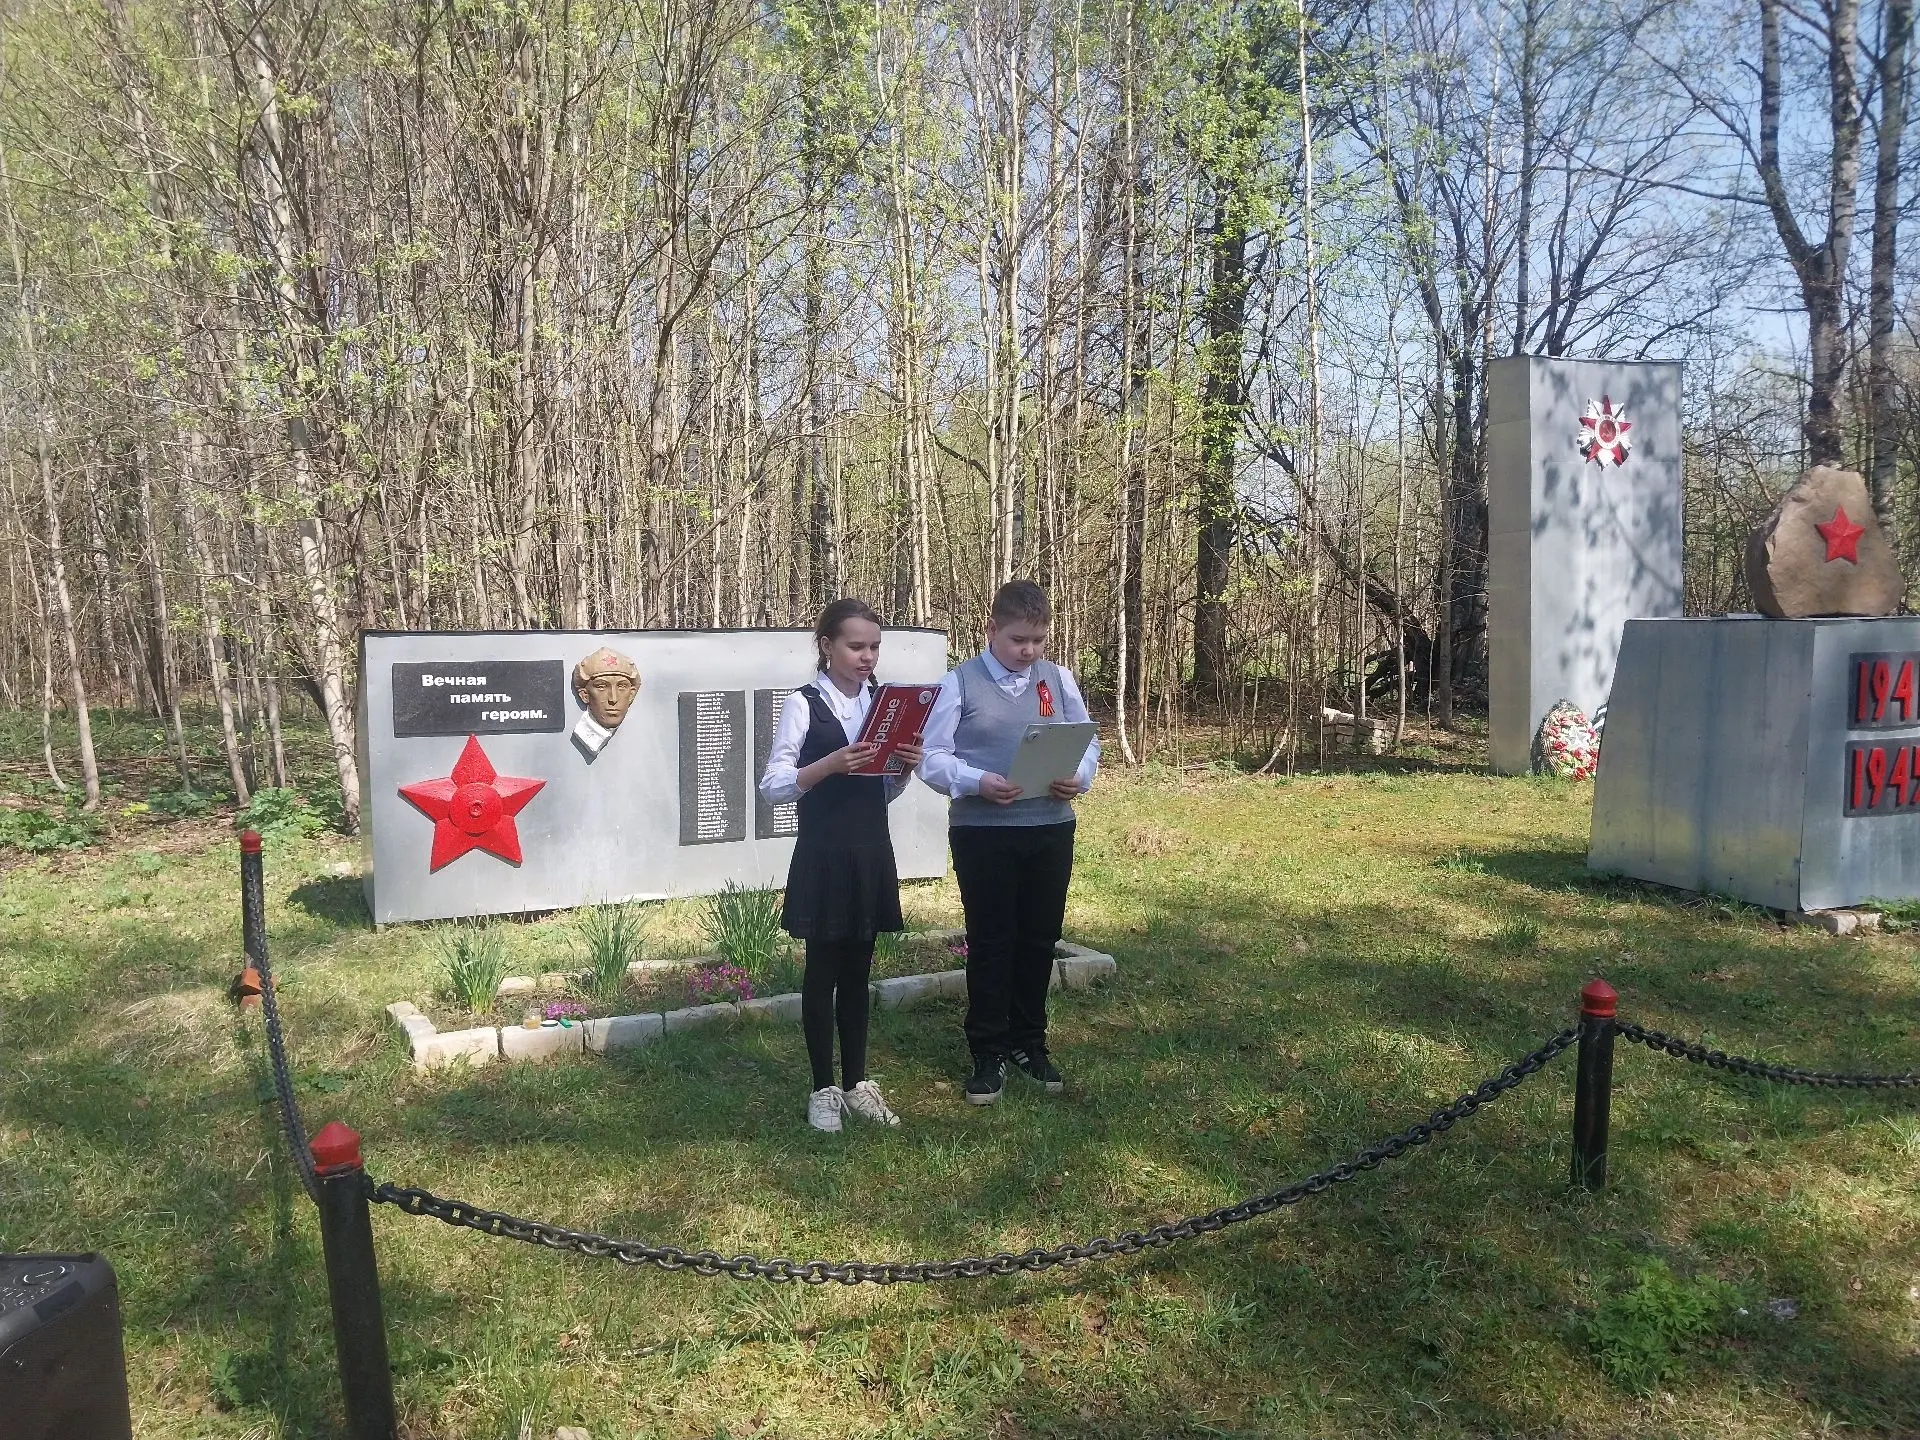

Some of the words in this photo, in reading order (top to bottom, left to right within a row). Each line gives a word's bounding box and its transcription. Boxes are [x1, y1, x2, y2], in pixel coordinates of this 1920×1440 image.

[421, 674, 487, 686] Вечная
[1856, 659, 1920, 721] 194
[450, 693, 511, 703] память
[481, 709, 547, 722] героям.
[868, 698, 900, 762] ервые
